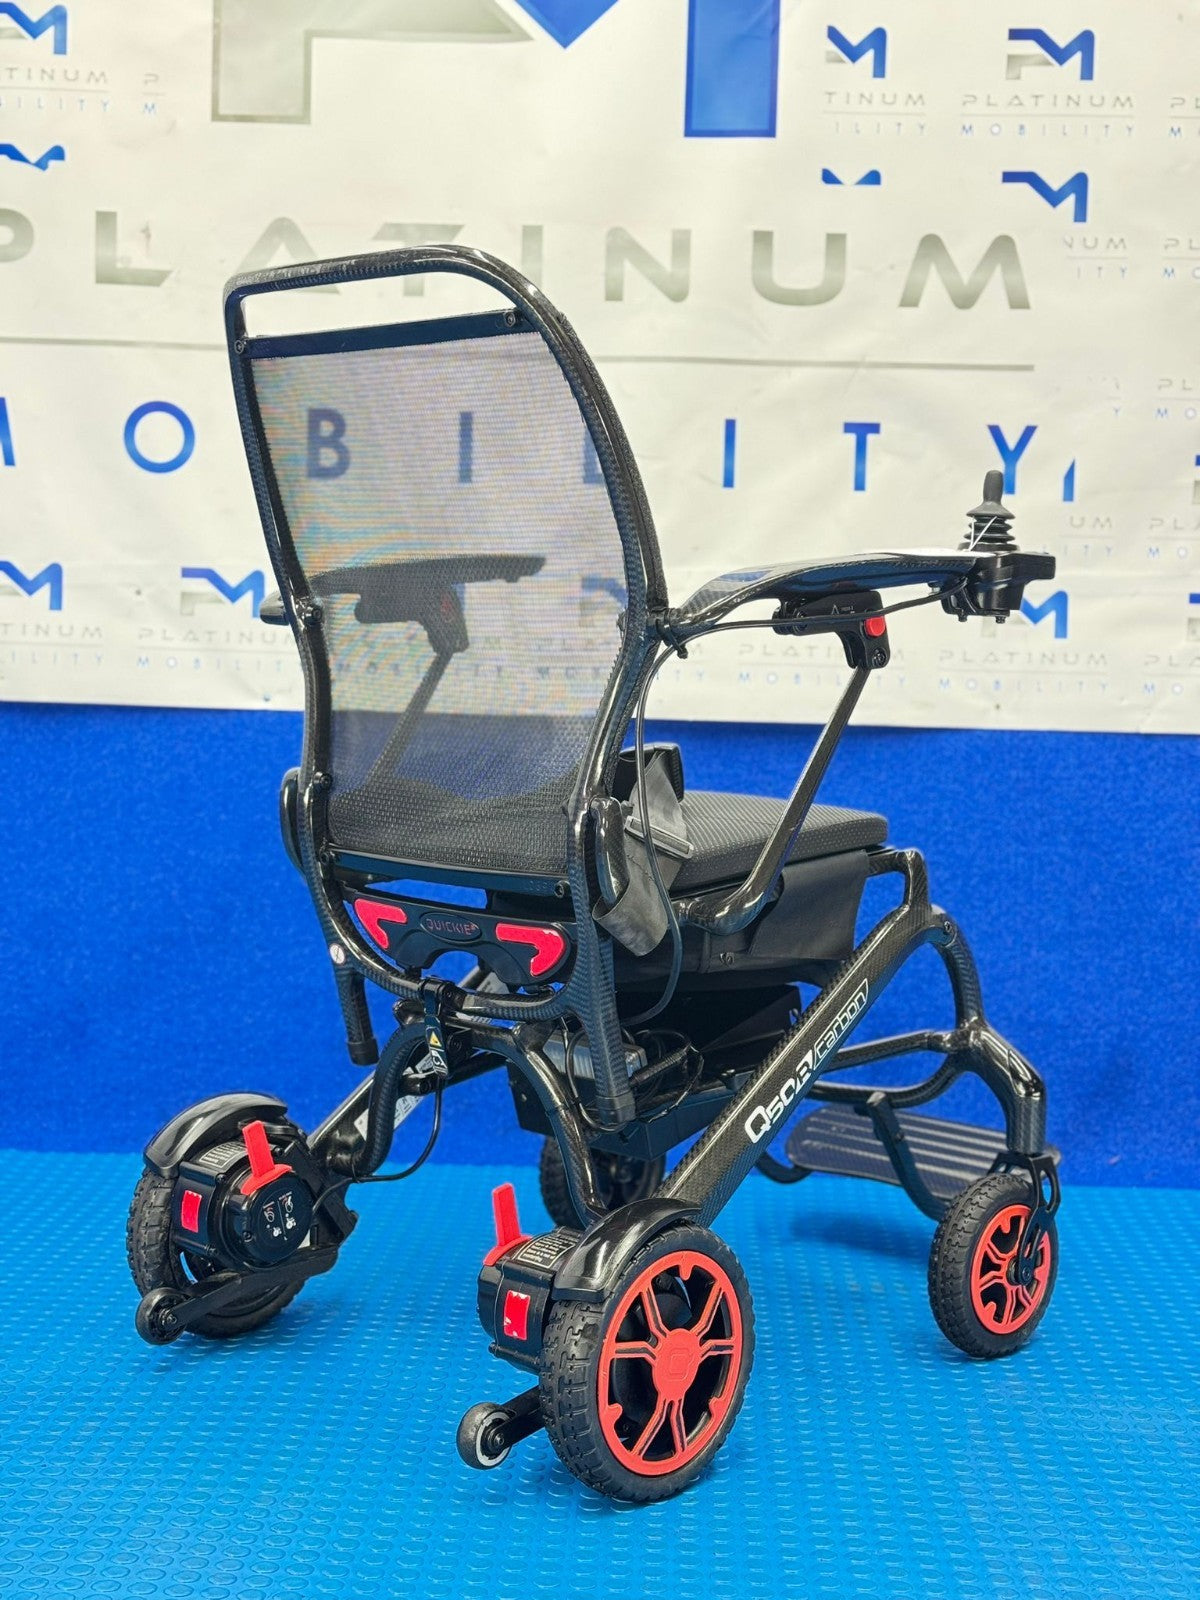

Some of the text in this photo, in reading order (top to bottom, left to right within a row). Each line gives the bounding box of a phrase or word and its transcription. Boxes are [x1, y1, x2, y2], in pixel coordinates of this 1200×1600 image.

[961, 94, 1135, 108] PLATINUM
[961, 123, 1134, 137] MOBILITY
[939, 650, 1108, 666] PLATINUM
[739, 671, 907, 686] MOBILTY
[939, 677, 1108, 693] MOBILITY
